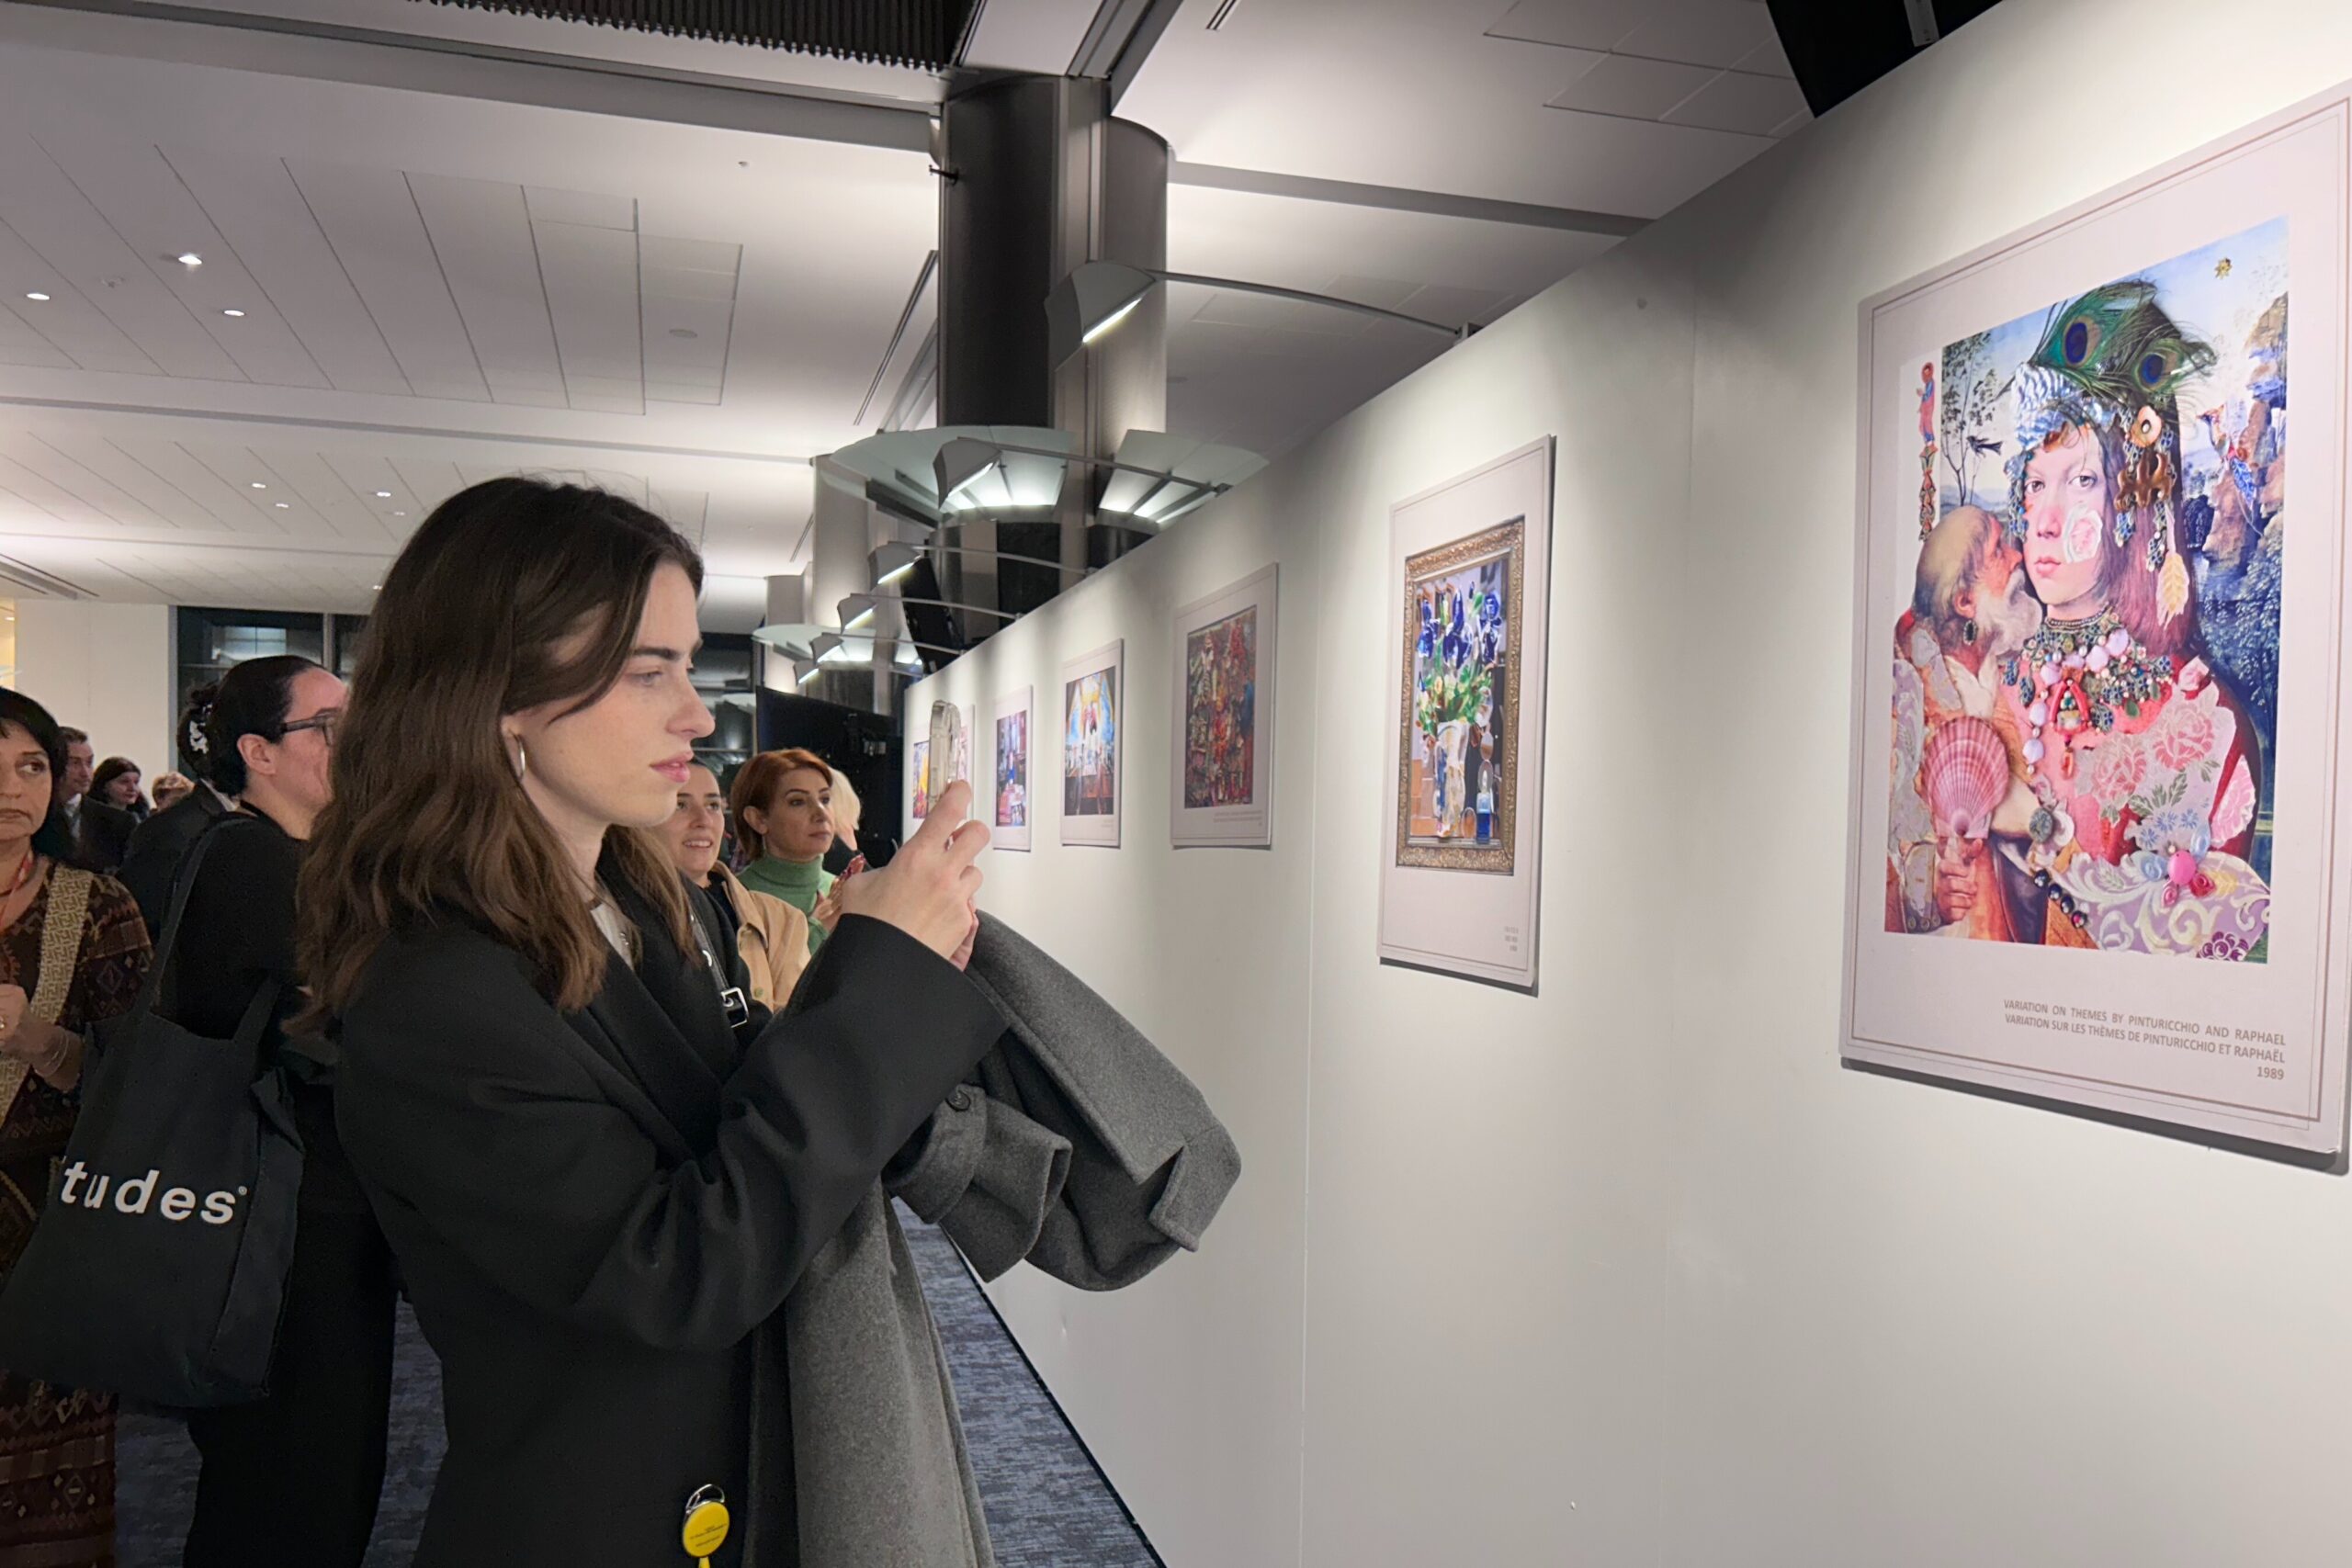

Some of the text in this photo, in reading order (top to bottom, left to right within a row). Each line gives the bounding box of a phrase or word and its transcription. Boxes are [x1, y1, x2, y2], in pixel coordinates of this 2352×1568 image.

[2004, 999, 2286, 1046] VARIATION ON THEMES BY PINTURICCHIO AND RAPHAEL
[2005, 1013, 2286, 1063] VARIATION SUR LES THÈMES DE PINTURICCHIO ET RAPHAËL
[2256, 1066, 2285, 1080] 1989
[60, 1156, 237, 1224] tudes
